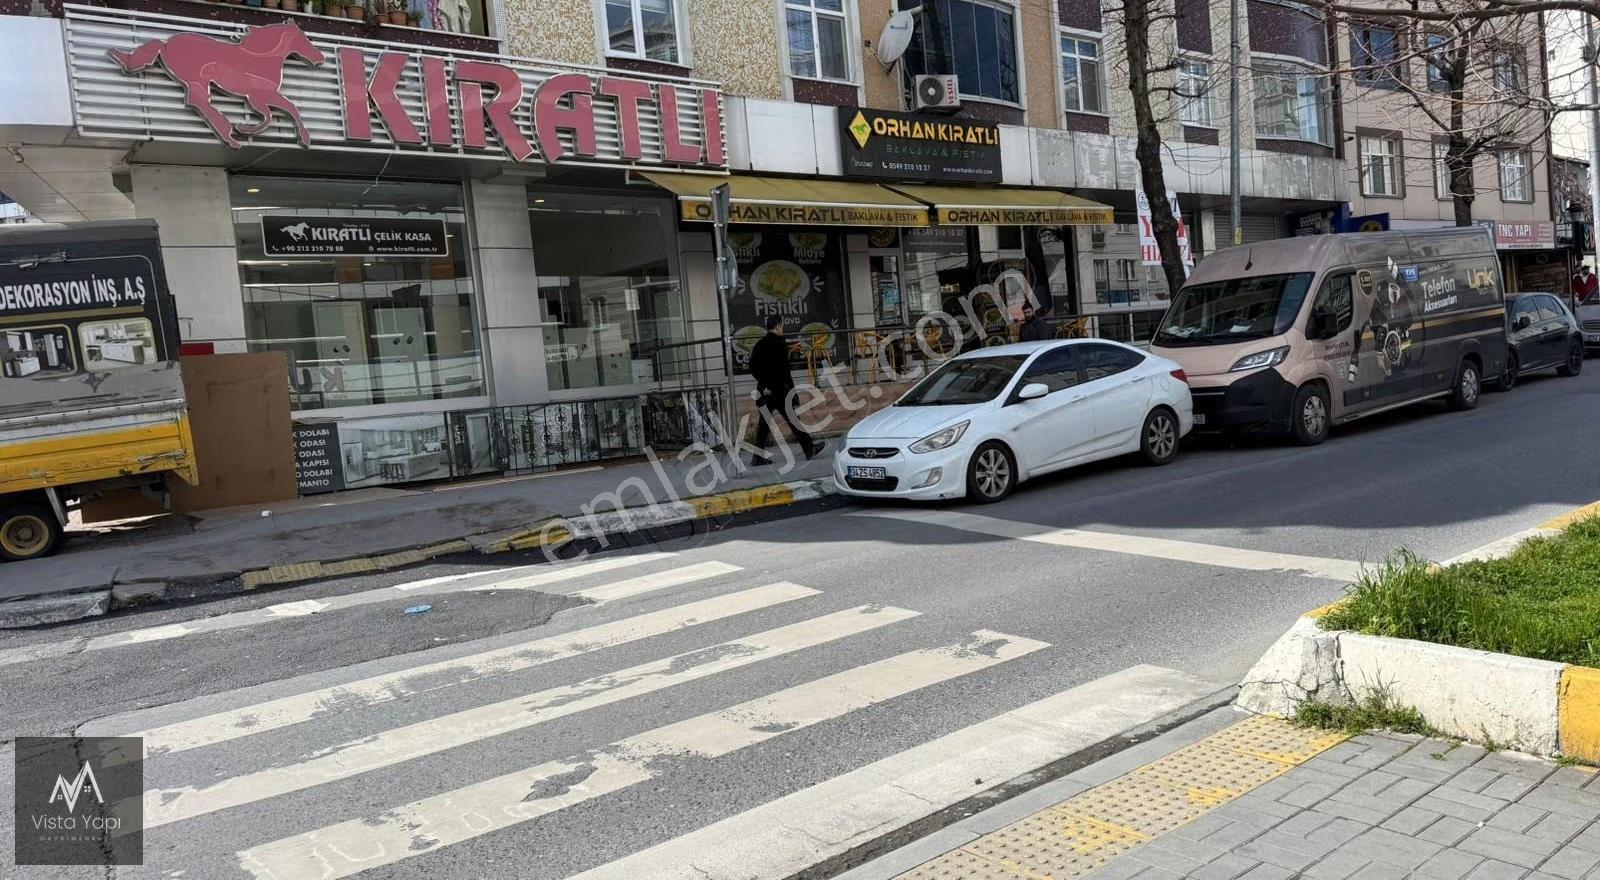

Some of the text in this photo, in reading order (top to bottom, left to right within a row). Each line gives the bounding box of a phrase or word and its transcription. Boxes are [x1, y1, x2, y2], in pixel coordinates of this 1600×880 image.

[336, 46, 726, 166] KIRATLI
[873, 117, 999, 145] ORHAN KIRATLI
[695, 204, 771, 220] OHAN
[775, 205, 845, 222] KIRATLI
[848, 211, 885, 221] BAKLAVA
[886, 212, 893, 221] &
[947, 209, 999, 224] ORHAN
[1003, 210, 1053, 223] KIRATLI
[311, 227, 432, 243] KIRATLI ÇELİK KASA
[1498, 224, 1513, 237] TNC
[1514, 224, 1532, 237] YAPI
[376, 245, 438, 254] www.kiratli.com.tr
[0, 274, 146, 310] DEKORASYON İNŞ. A.Ş
[1421, 275, 1456, 300] Telefon
[300, 429, 330, 438] DOLABI
[300, 439, 326, 448] ODASI
[298, 449, 325, 458] ODASI
[302, 459, 330, 468] KAPISI
[303, 469, 333, 477] DOLABI
[859, 468, 868, 477] ZS
